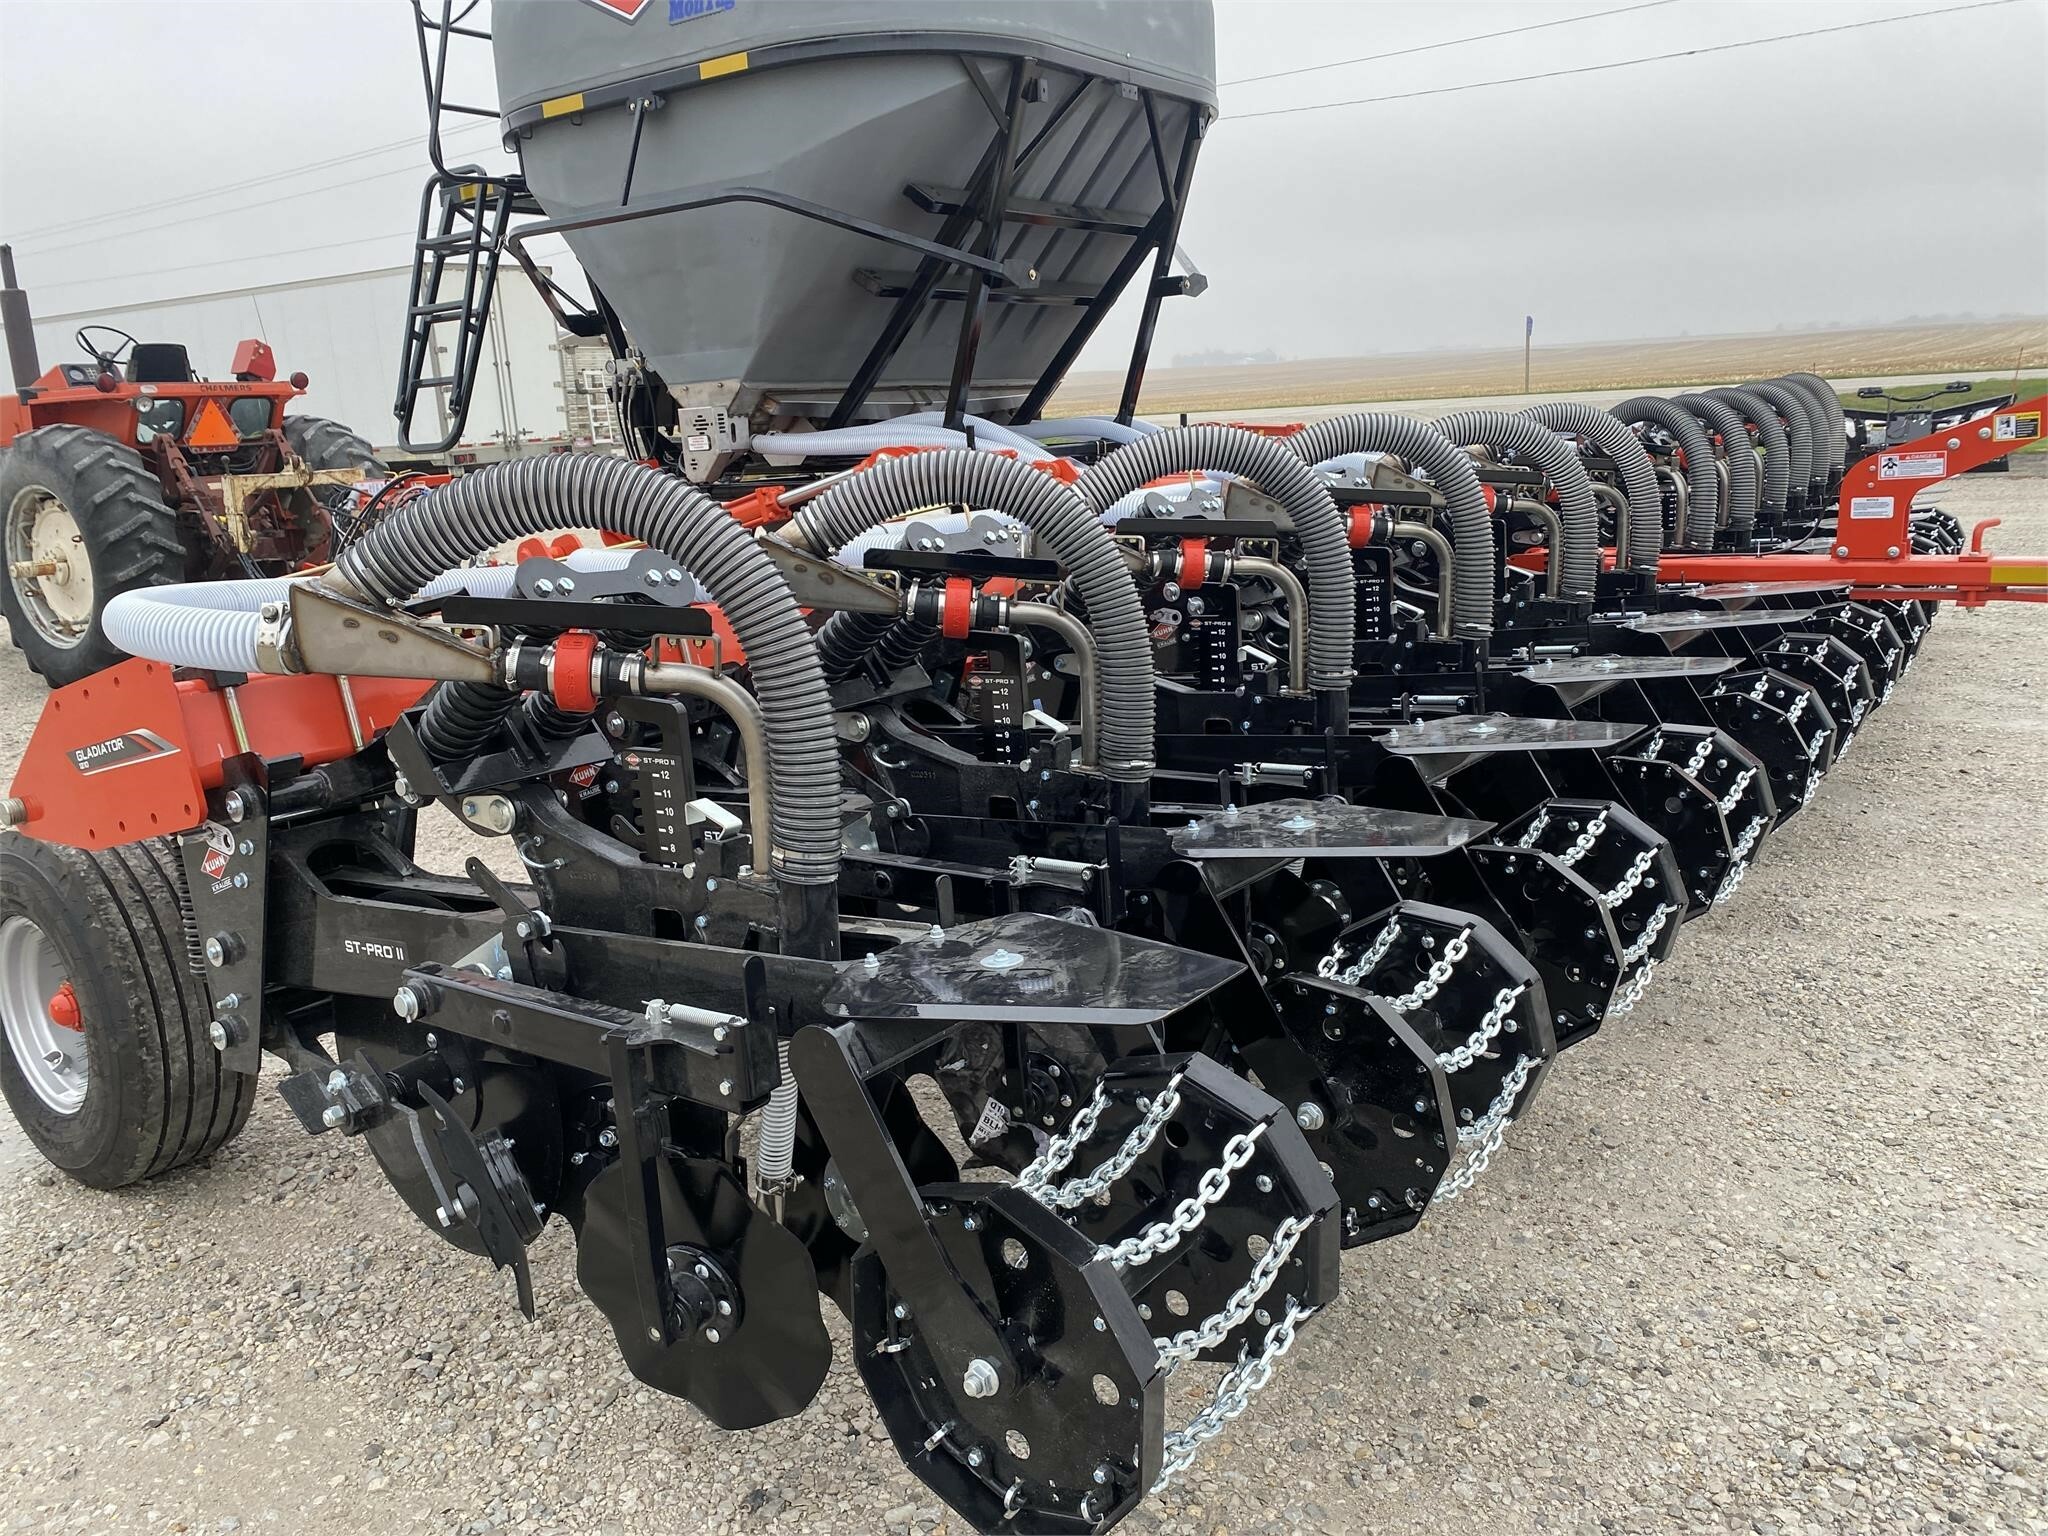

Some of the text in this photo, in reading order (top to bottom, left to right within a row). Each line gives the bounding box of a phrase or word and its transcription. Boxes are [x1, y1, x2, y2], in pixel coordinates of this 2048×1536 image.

[200, 384, 252, 392] CHALMERS
[1154, 626, 1173, 638] KUHN
[1002, 716, 1011, 724] 10
[1004, 731, 1010, 739] 9
[75, 738, 125, 762] GLADIATOR
[1005, 745, 1011, 753] 8
[643, 757, 669, 765] ST-PRO
[573, 766, 597, 783] KUHN
[660, 770, 670, 780] 12
[579, 785, 602, 799] KRAUSE
[662, 789, 672, 798] 11
[664, 807, 675, 817] 10
[667, 825, 674, 835] 9
[670, 844, 676, 853] 8
[205, 854, 226, 873] KUHN
[672, 861, 678, 869] 7
[211, 879, 232, 892] KRAUSE
[344, 939, 404, 961] ST-PRO II
